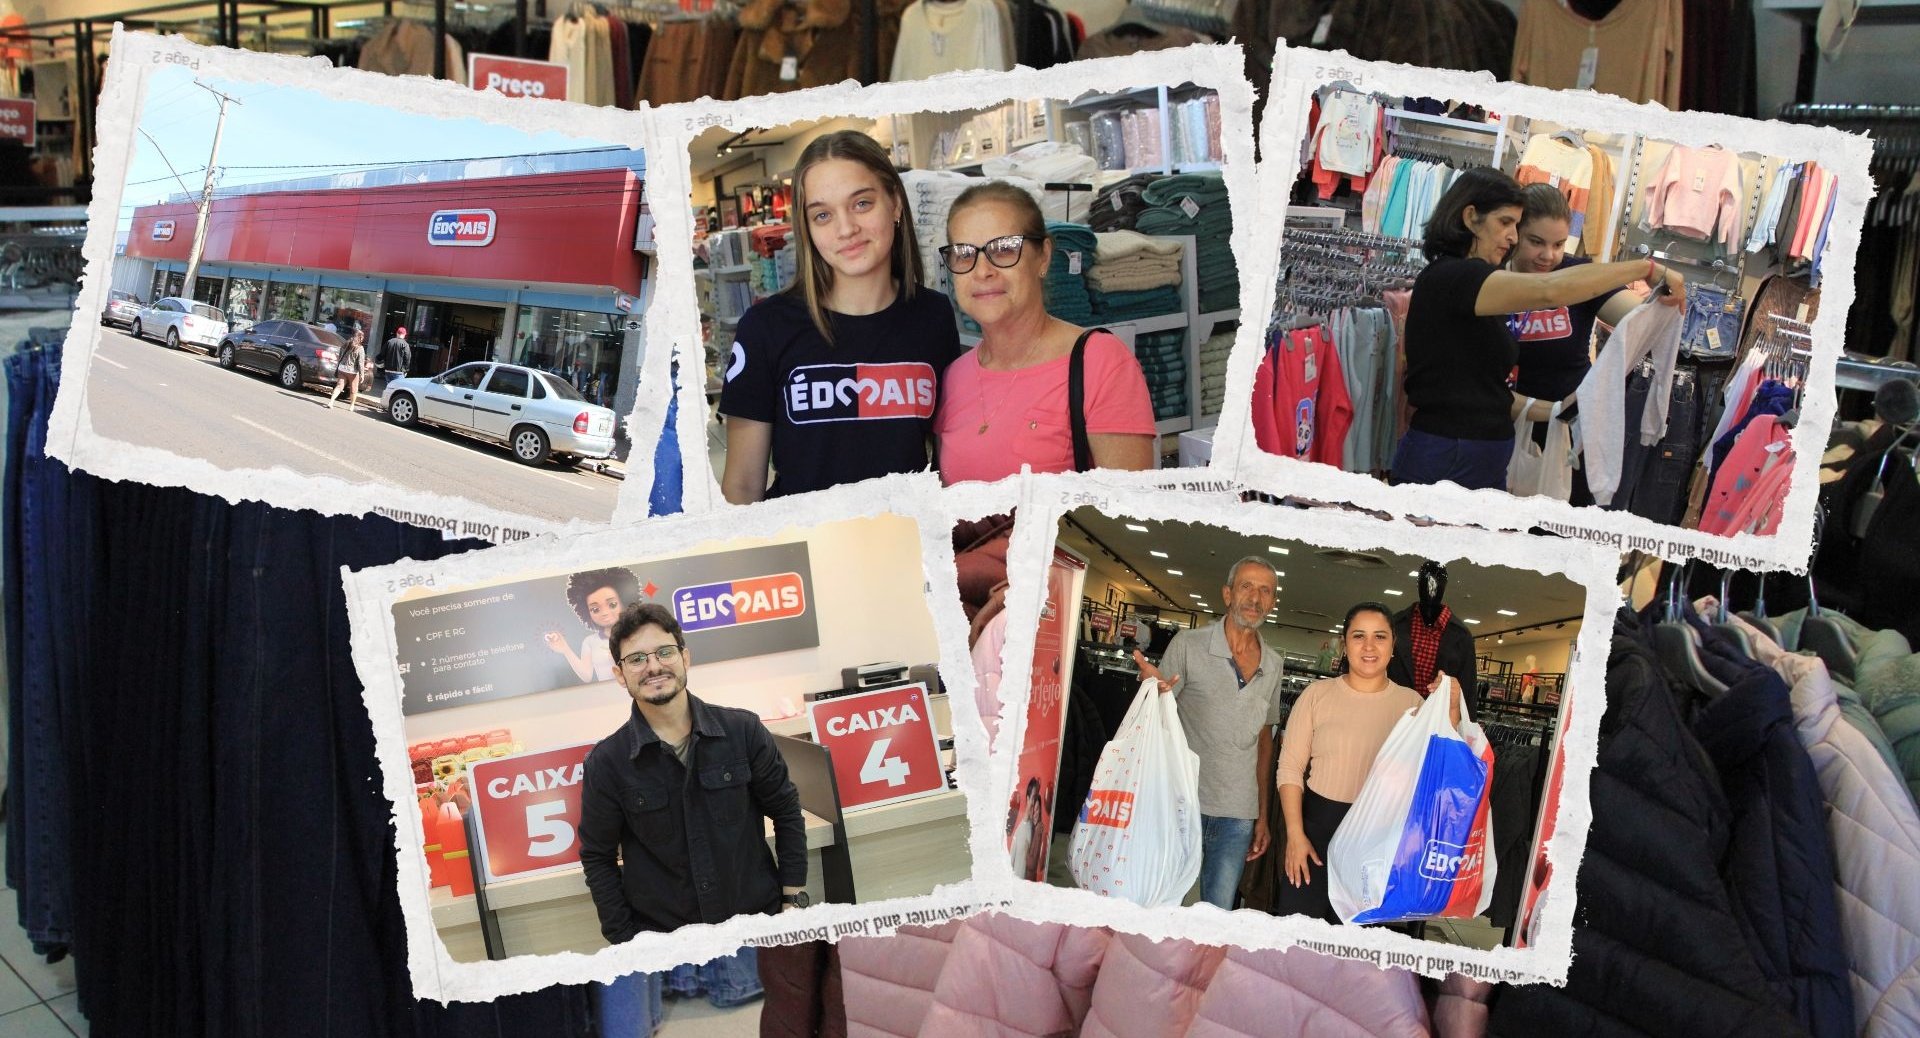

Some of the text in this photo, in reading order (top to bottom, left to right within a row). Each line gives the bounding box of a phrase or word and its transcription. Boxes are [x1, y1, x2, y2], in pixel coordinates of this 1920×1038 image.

[152, 51, 200, 70] Page 2
[1315, 66, 1363, 86] Page 2
[685, 112, 733, 131] Page 2
[1060, 491, 1108, 510] Page 2
[462, 521, 499, 542] Joint
[1627, 534, 1664, 554] Joint
[1668, 541, 1697, 560] and
[387, 574, 436, 593] Page 2
[410, 607, 430, 617] Você
[432, 602, 461, 615] precisa
[463, 596, 501, 608] somente
[426, 627, 465, 641] CPF E RG
[431, 642, 525, 666] 2 números de telefone
[433, 658, 485, 674] para contato
[427, 692, 433, 703] É
[435, 688, 463, 701] rápido
[826, 704, 921, 736] CAIXA
[860, 738, 911, 787] 4
[488, 763, 584, 798] CAIXA
[526, 800, 575, 857] 5
[833, 918, 869, 937] Joint
[874, 914, 902, 932] and
[1386, 951, 1421, 970] Joint
[1427, 957, 1455, 973] and
